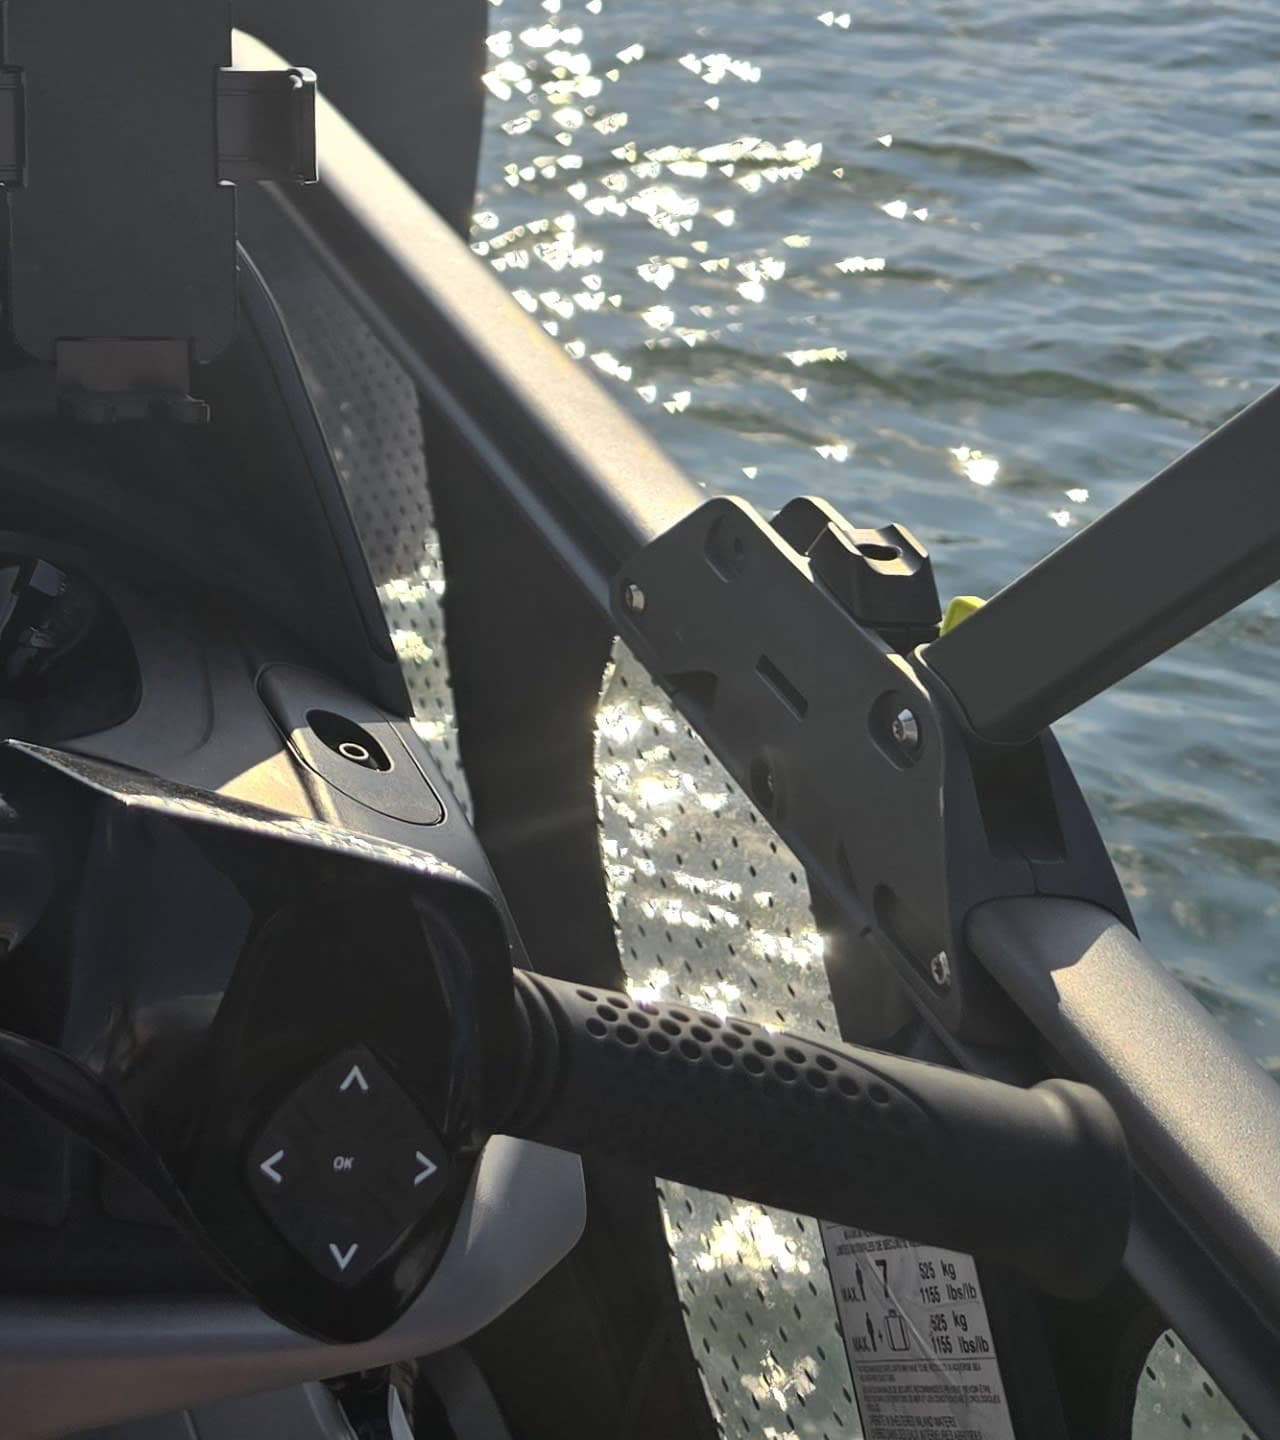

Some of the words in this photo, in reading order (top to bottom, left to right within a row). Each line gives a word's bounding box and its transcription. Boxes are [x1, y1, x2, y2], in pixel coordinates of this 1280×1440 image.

[333, 1155, 355, 1170] OK
[875, 1259, 890, 1298] 7
[918, 1261, 936, 1280] 525
[940, 1259, 957, 1281] kg
[919, 1285, 941, 1304] 1155
[945, 1283, 978, 1301] lbs/lb
[930, 1313, 948, 1332] 525
[952, 1310, 968, 1332] kg
[931, 1335, 953, 1354] 1155
[957, 1334, 990, 1353] lbs/lb
